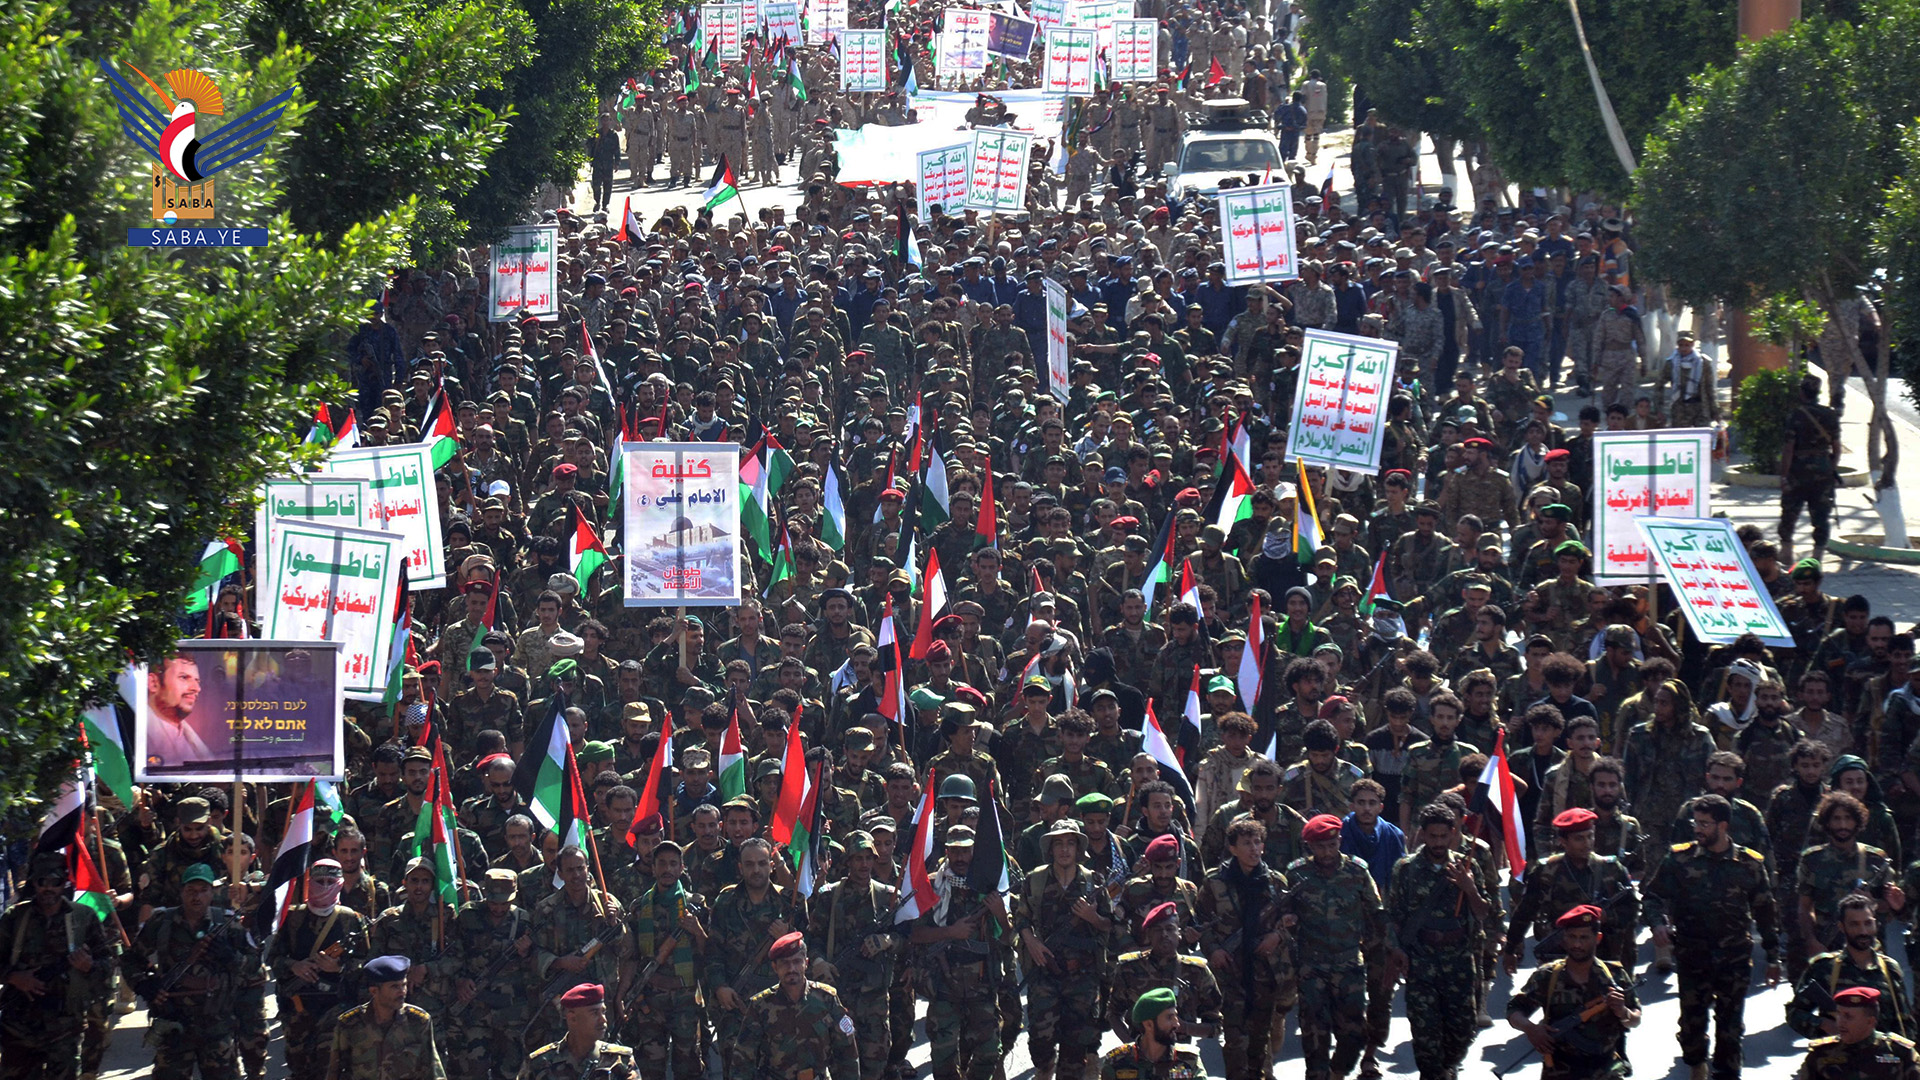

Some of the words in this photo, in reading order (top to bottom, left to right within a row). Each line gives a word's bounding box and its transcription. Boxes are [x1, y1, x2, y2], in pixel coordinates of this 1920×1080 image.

[1053, 36, 1089, 49] قاطعوا
[1230, 198, 1282, 220] قاطعوا
[1261, 221, 1284, 236] البضائع
[1236, 254, 1288, 272] الإسرائيلية
[1311, 350, 1356, 372] أكبر
[1356, 356, 1384, 374] الله
[1309, 372, 1347, 390] لأمريكا
[1348, 381, 1380, 395] الموت
[1305, 393, 1343, 413] لإسرائيل
[1345, 401, 1376, 415] الموت
[1302, 414, 1329, 429] اليهود
[1330, 418, 1346, 431] على
[1349, 419, 1373, 434] اللعنة
[1298, 430, 1335, 454] للإسلام
[1336, 438, 1370, 456] النصر
[652, 459, 711, 483] كتيبة
[1607, 451, 1694, 482] قاطعوا
[272, 494, 355, 517] قاطعوا
[656, 489, 683, 510] علي
[688, 488, 725, 507] الامام
[1654, 488, 1694, 511] البضائع
[385, 498, 421, 522] البضائع
[1663, 531, 1700, 556] أكبر
[1705, 535, 1732, 552] الله
[287, 544, 381, 580] قاطعوا
[1667, 556, 1709, 572] لأمريكا
[1710, 560, 1742, 574] الموت
[664, 566, 701, 579] طوفان
[1681, 576, 1720, 591] لإسرائيل
[1721, 579, 1752, 592] الموت
[282, 585, 332, 612] الأمريكية
[332, 590, 376, 618] البضائع
[1690, 595, 1718, 609] اليهود
[1721, 596, 1735, 610] على
[1735, 596, 1763, 608] اللعنة
[1701, 612, 1738, 632] للإسلام
[1743, 612, 1774, 632] النصر
[284, 698, 307, 711] לעם
[226, 716, 252, 730] לבד
[254, 716, 273, 730] לא
[275, 719, 306, 730] אתם
